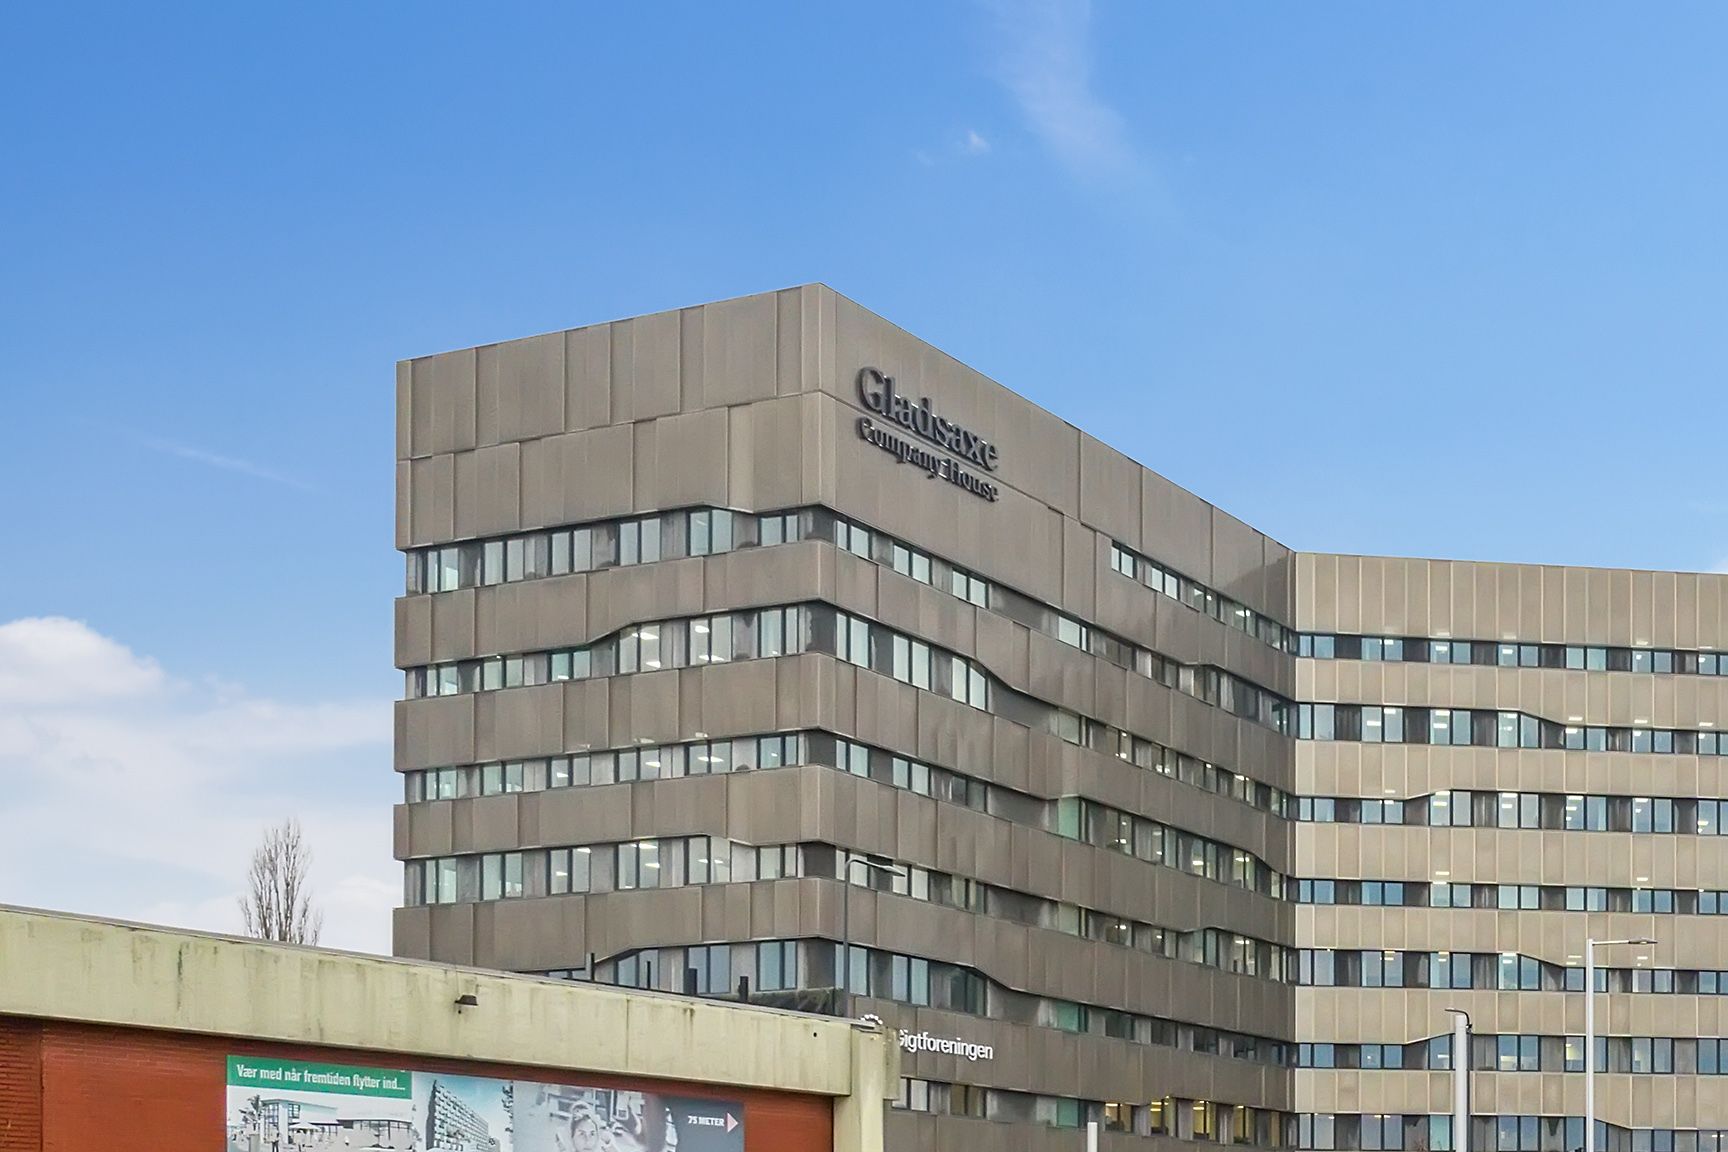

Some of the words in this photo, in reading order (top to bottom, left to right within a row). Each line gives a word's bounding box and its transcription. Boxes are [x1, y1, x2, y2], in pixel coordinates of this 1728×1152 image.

[856, 366, 999, 472] Gladsaxe
[856, 415, 943, 479] Company
[941, 457, 1000, 503] House
[236, 1063, 258, 1079] Vær
[260, 1065, 283, 1081] med
[284, 1067, 302, 1082] når
[303, 1070, 351, 1086] fremtiden
[352, 1074, 381, 1091] flytter
